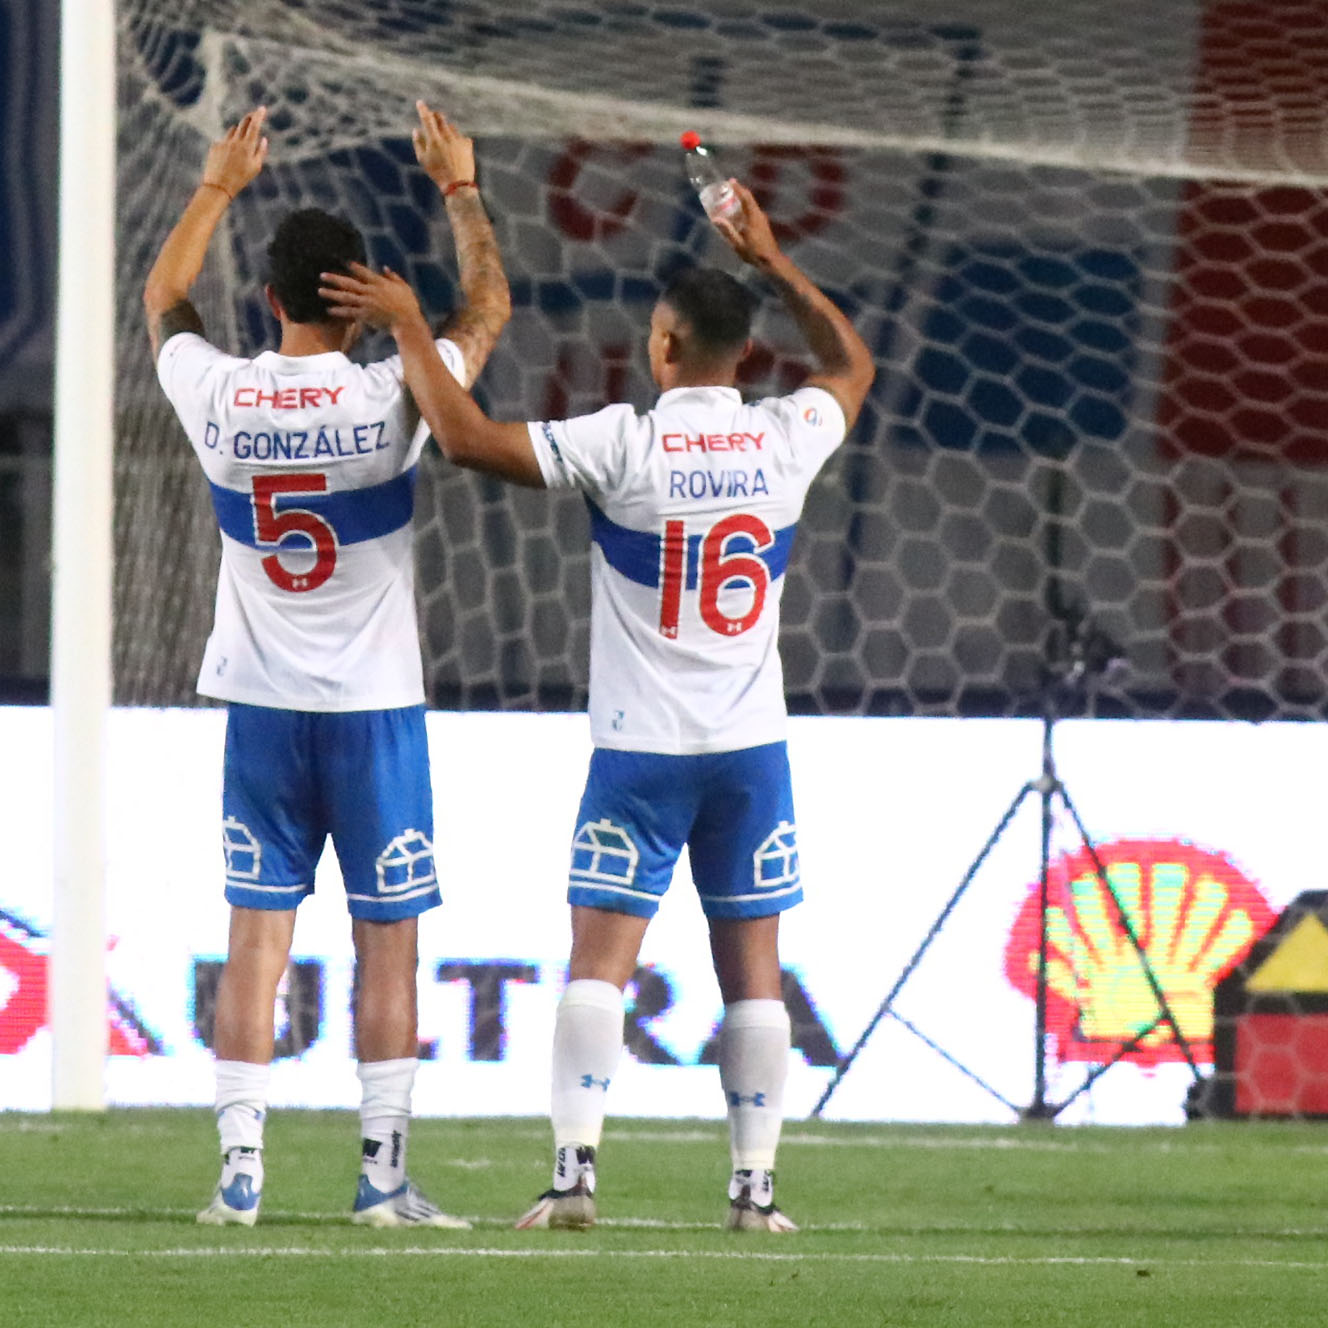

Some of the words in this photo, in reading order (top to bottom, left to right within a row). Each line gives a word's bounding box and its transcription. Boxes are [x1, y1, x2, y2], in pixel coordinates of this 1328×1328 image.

[234, 386, 347, 410] CHERY
[204, 420, 224, 456] D.
[233, 421, 390, 461] GONZÁLEZ
[661, 432, 765, 453] CHERY
[669, 468, 770, 499] ROVIRA
[250, 473, 339, 593] 5
[658, 513, 775, 640] 16
[186, 960, 834, 1070] UTRA
